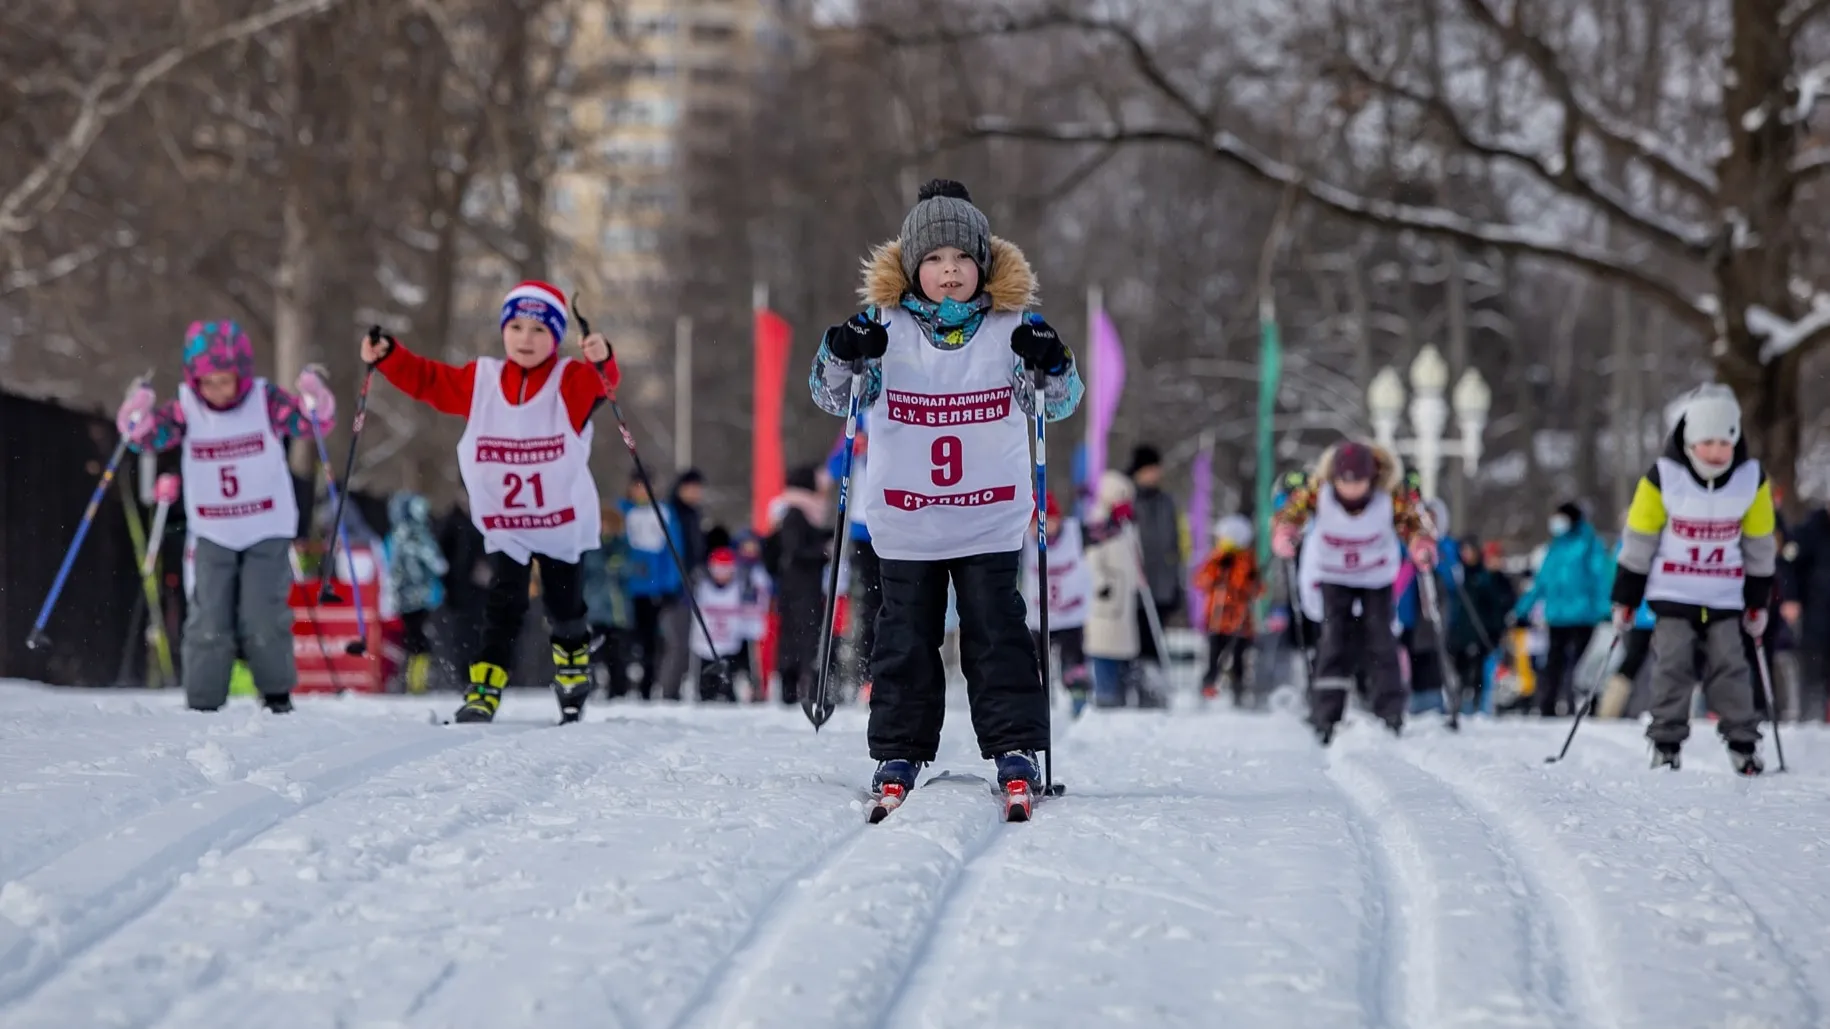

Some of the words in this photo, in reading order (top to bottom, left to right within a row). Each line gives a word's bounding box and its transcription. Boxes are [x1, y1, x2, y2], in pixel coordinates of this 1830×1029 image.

[888, 392, 946, 407] МЕМОРИАЛ
[949, 389, 1010, 406] АДМИРАЛА
[926, 404, 1003, 424] БЕЛЯЕВА
[931, 435, 963, 487] 9
[221, 465, 239, 498] 5
[503, 472, 545, 509] 21
